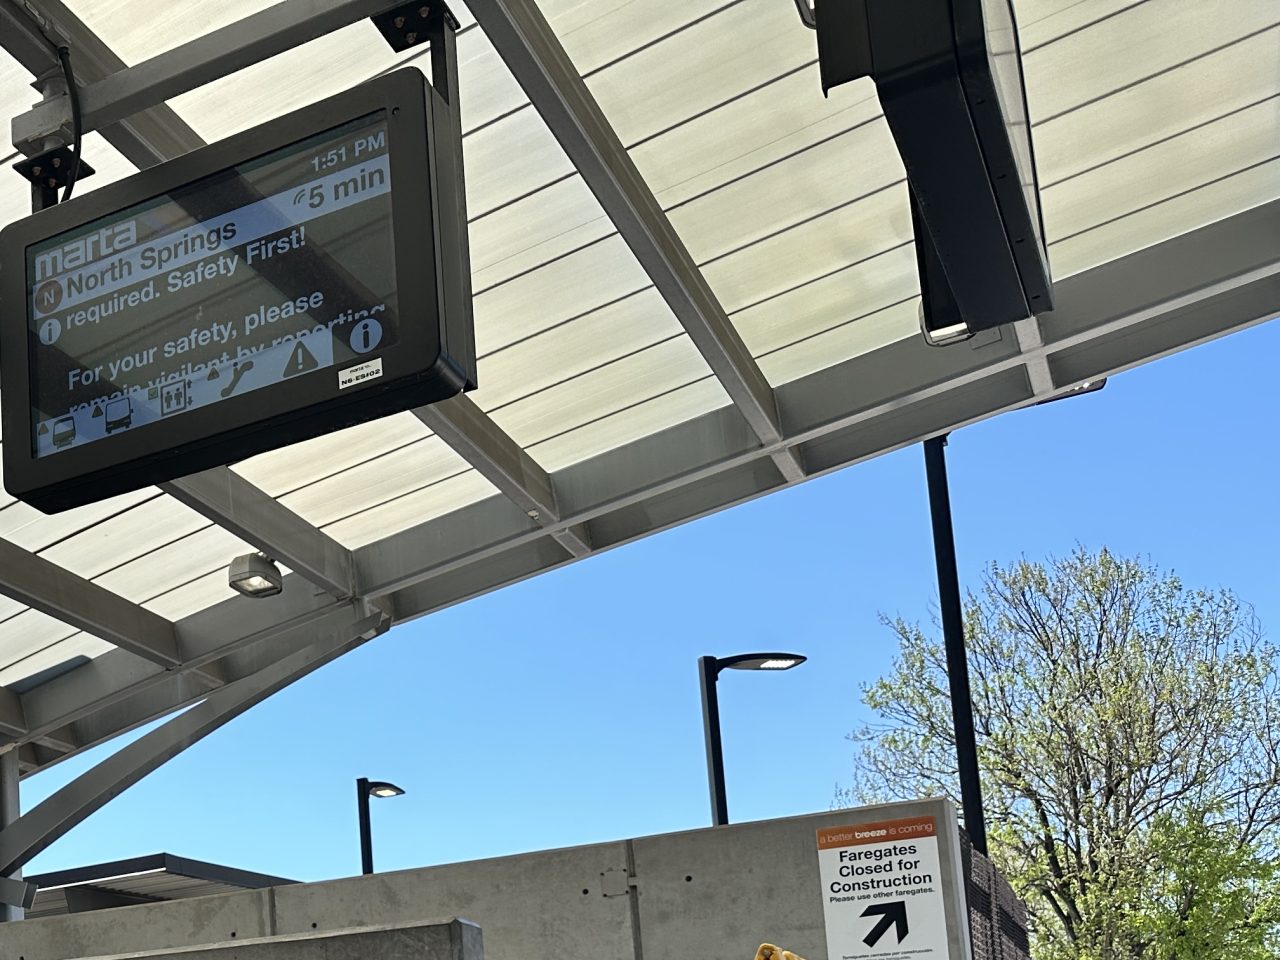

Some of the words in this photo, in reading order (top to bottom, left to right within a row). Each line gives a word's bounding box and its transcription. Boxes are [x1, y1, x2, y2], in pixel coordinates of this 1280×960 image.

[311, 145, 346, 172] 1:51
[354, 131, 385, 157] PM
[308, 184, 325, 209] 5
[333, 168, 385, 201] min
[35, 220, 137, 282] marta
[66, 258, 133, 299] North
[139, 222, 237, 273] Springs
[66, 281, 161, 330] required.
[167, 254, 240, 293] Safety
[246, 226, 306, 265] First!
[44, 290, 55, 306] N
[68, 363, 105, 391] For
[108, 348, 157, 382] your
[163, 321, 238, 359] safety,
[244, 291, 324, 336] please
[827, 831, 854, 843] better
[854, 829, 887, 839] breeze
[889, 827, 896, 835] is
[898, 823, 933, 833] coming
[839, 845, 917, 863] Faregates
[839, 860, 893, 878] Closed
[897, 859, 920, 871] for
[830, 874, 932, 894] Construction
[872, 890, 893, 899] other
[895, 887, 935, 897] faregates.
